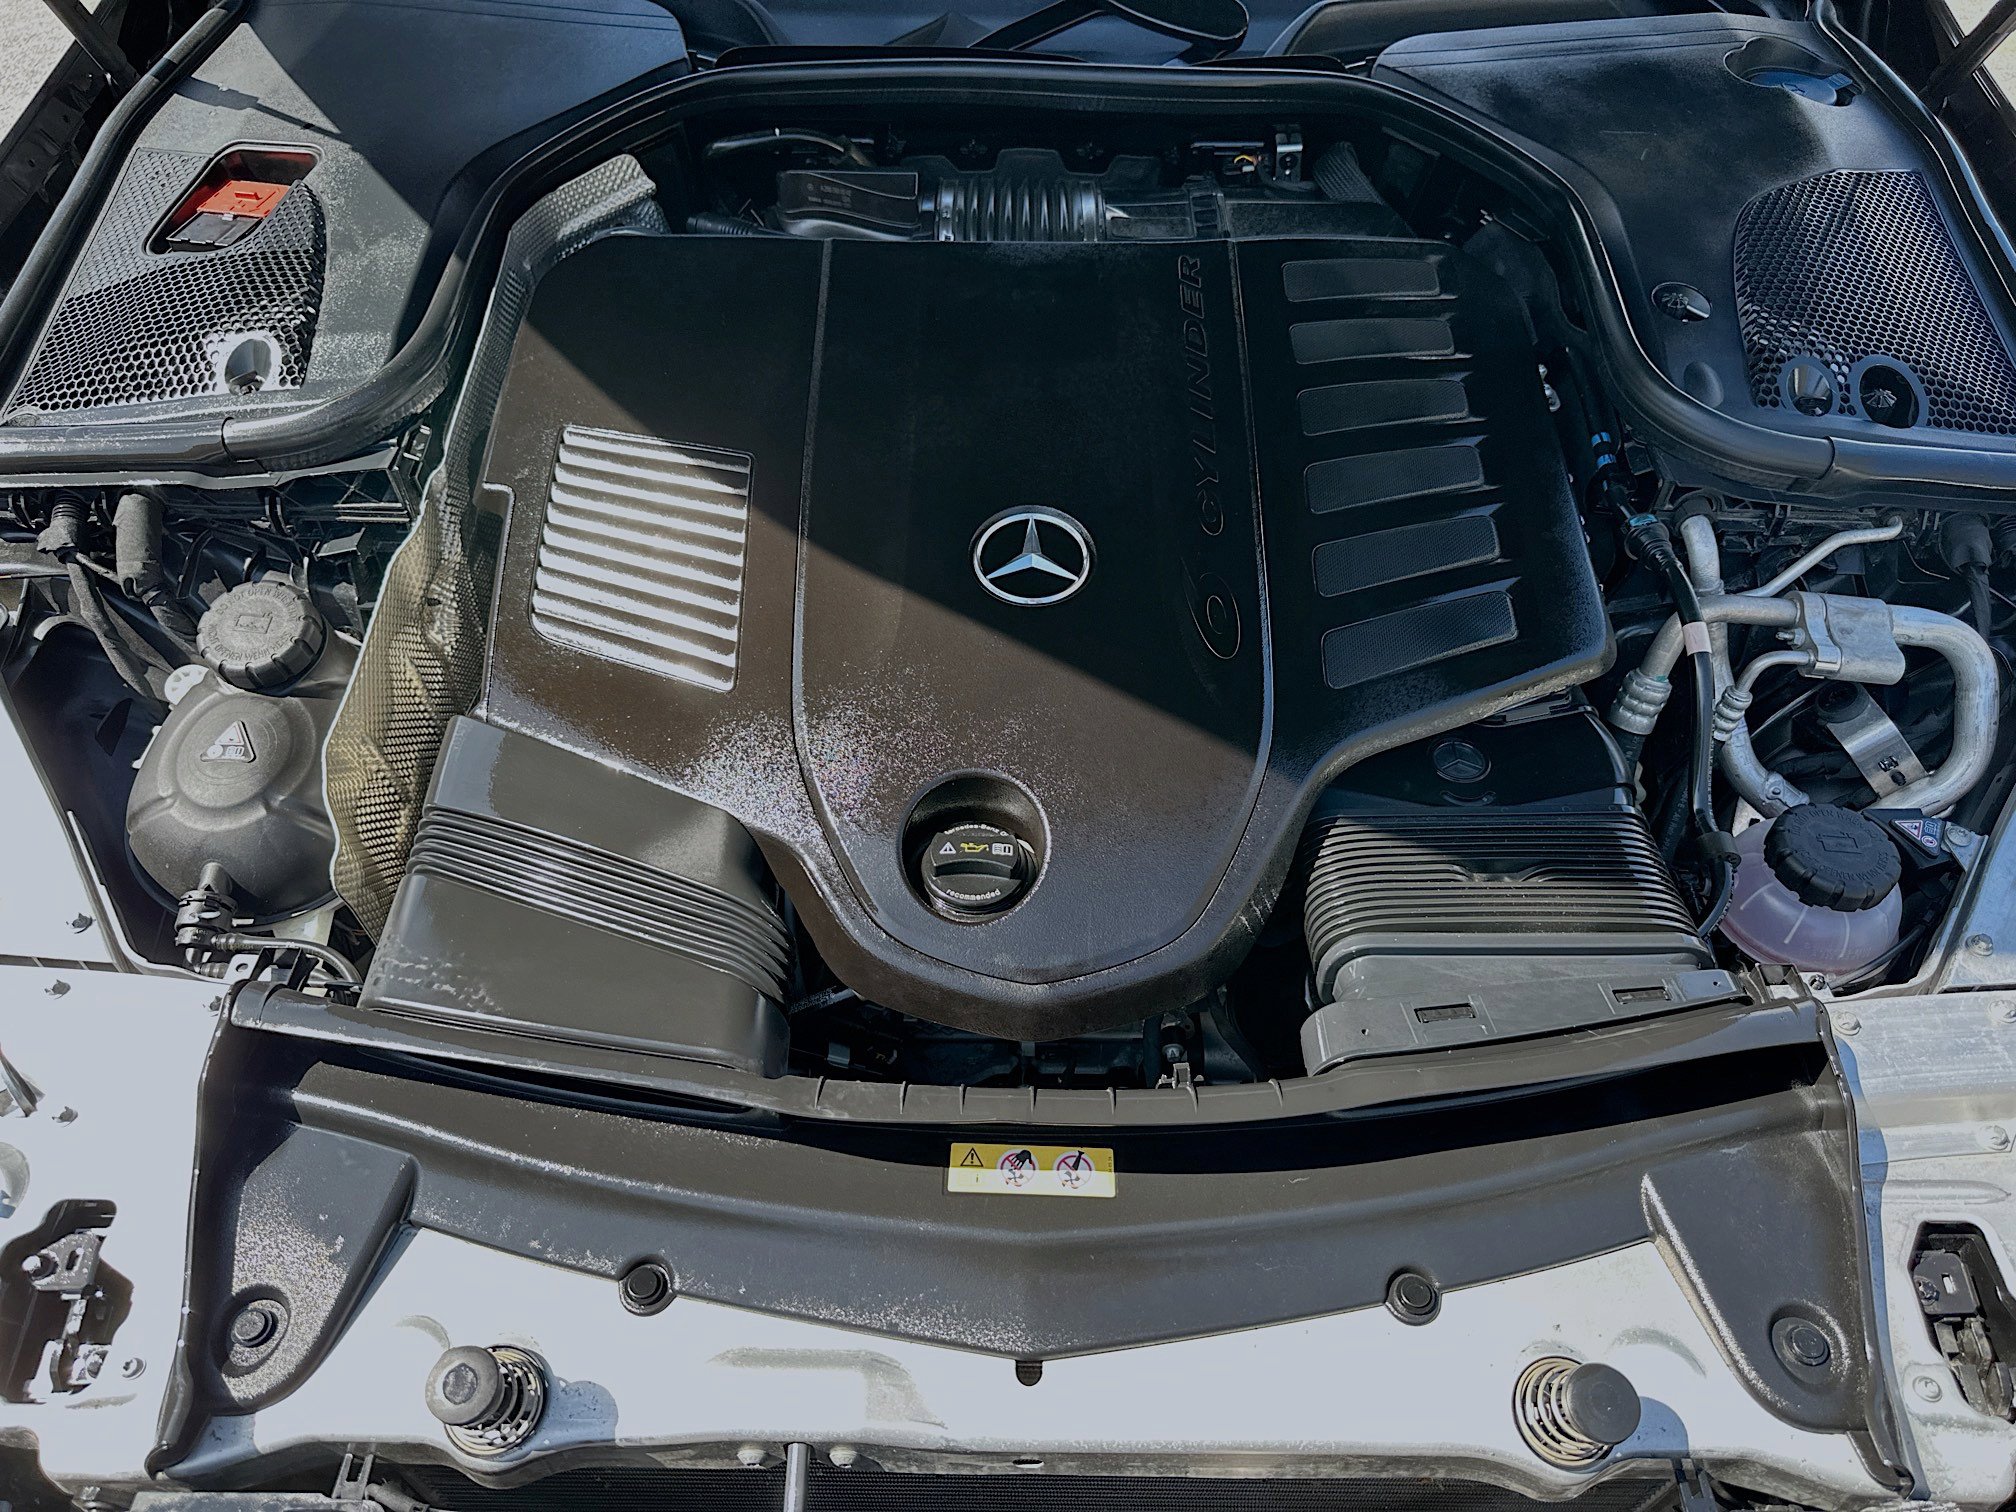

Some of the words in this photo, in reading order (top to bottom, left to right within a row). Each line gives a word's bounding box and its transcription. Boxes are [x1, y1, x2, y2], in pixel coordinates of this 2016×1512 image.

[1178, 254, 1224, 536] CYLINDER
[247, 587, 272, 598] OPEN
[945, 888, 1002, 901] recommended
